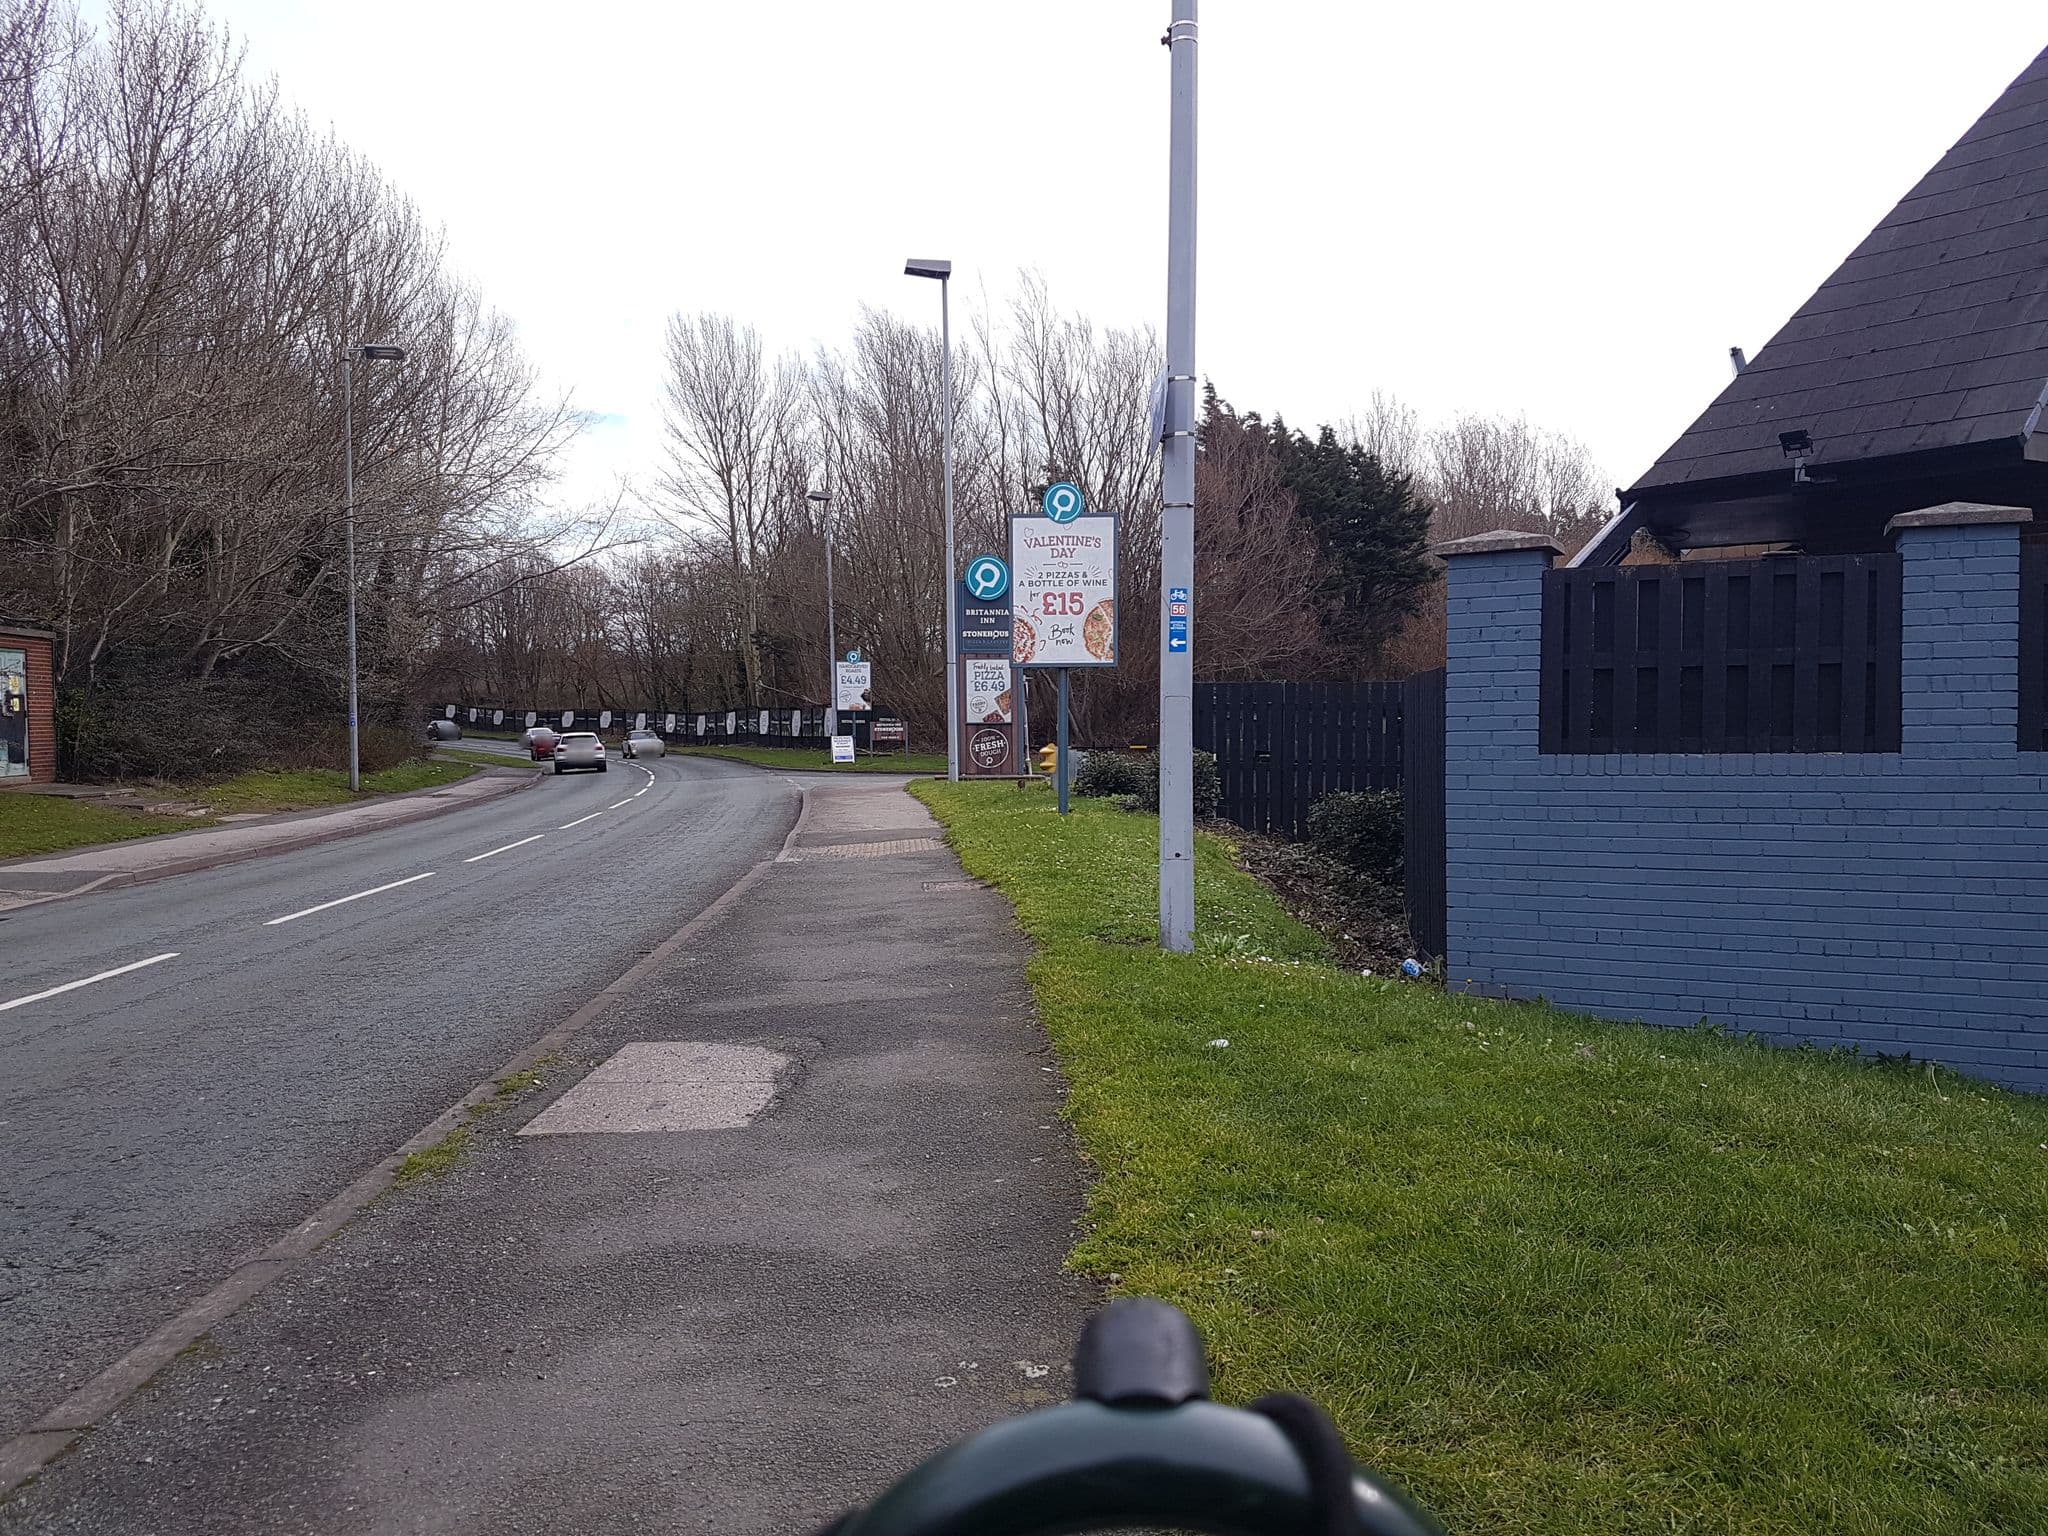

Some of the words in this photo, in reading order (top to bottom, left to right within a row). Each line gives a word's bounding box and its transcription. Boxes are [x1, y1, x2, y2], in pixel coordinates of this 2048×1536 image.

[1024, 535, 1102, 548] VALENTINE'S
[1050, 548, 1076, 558] DAY
[1030, 590, 1040, 602] for
[1042, 592, 1084, 616] £15
[1172, 605, 1185, 614] 56
[962, 630, 1010, 640] STONEHOUS
[1048, 622, 1075, 640] Book
[1056, 638, 1074, 646] now
[841, 675, 866, 684] £4.49
[974, 672, 1005, 680] PIZZA
[974, 680, 1006, 692] £6.49
[974, 740, 1004, 752] FRESH
